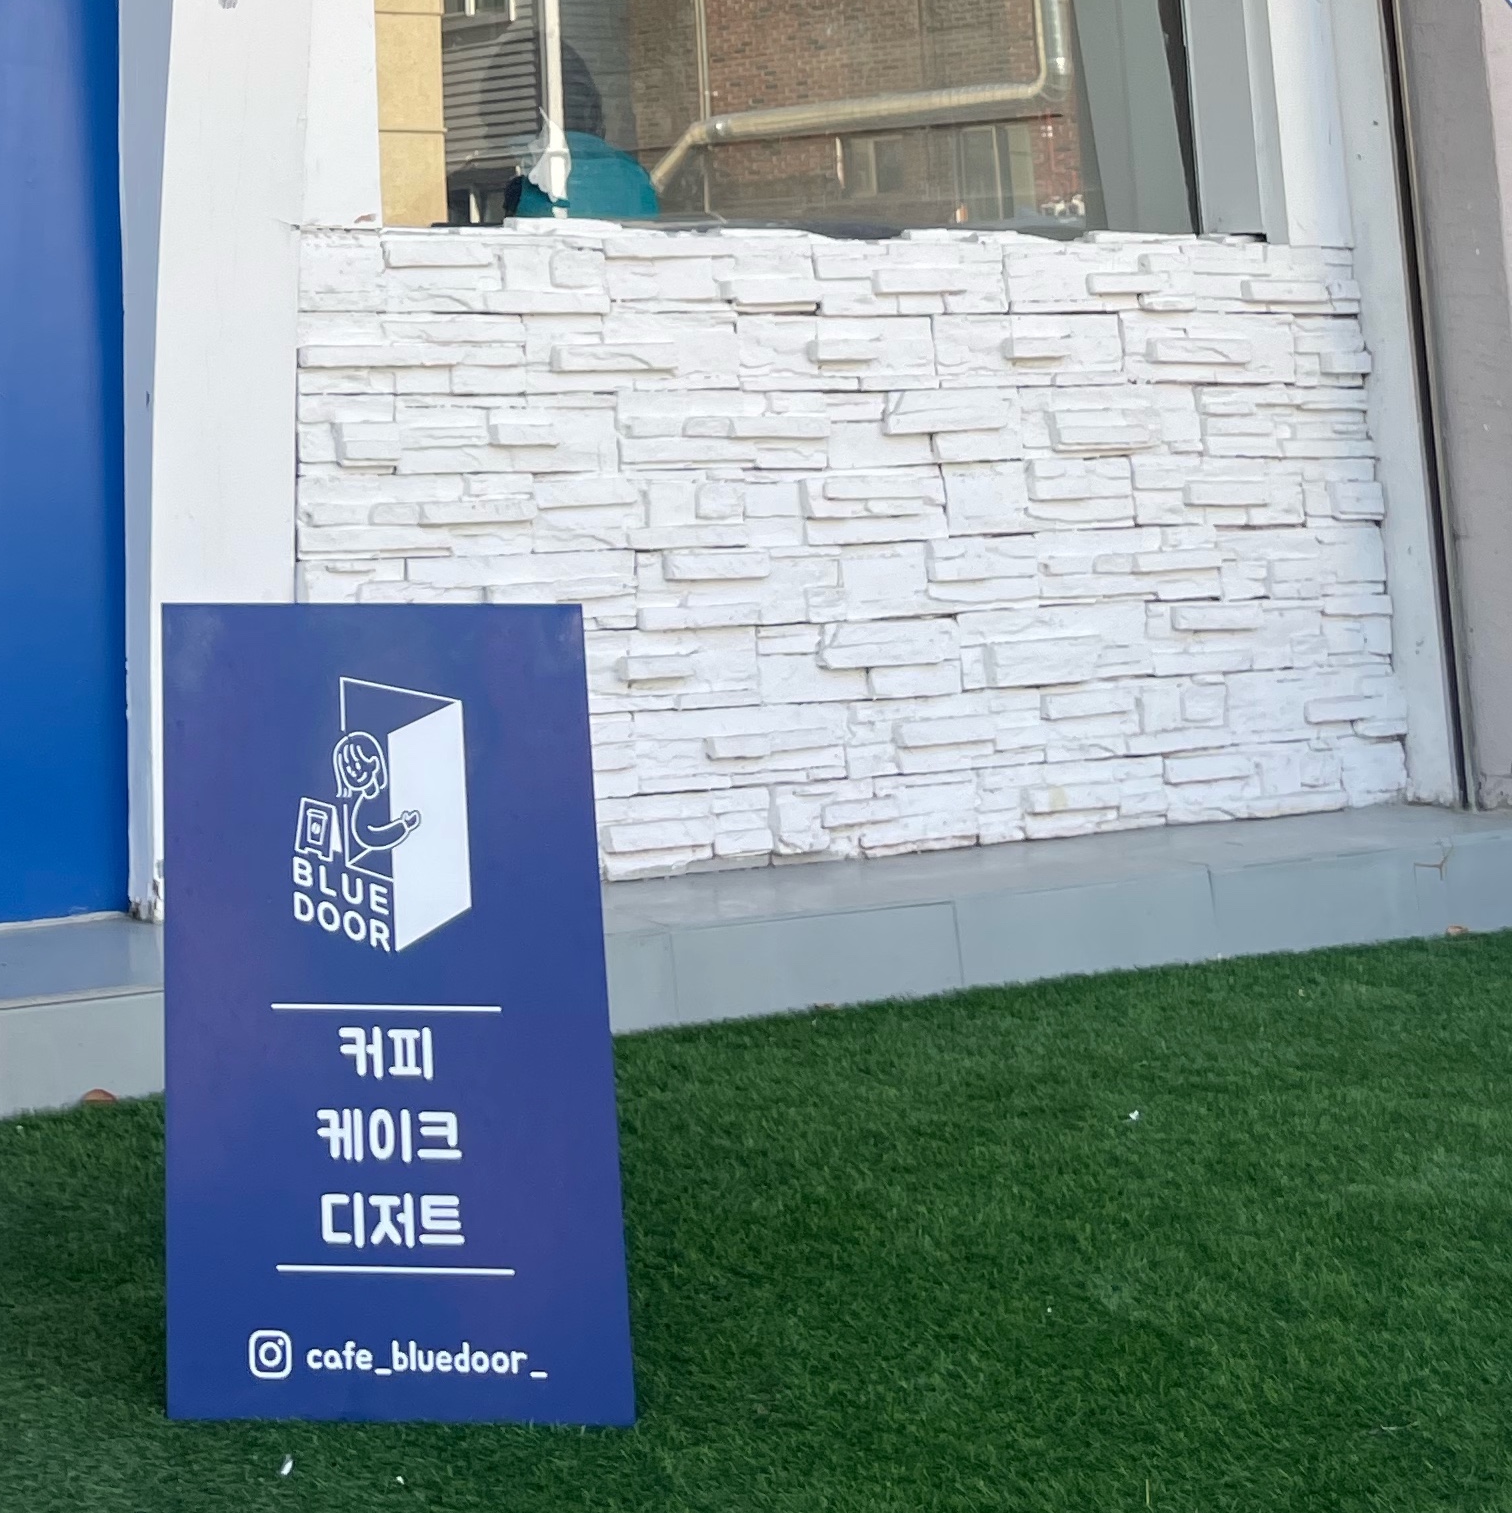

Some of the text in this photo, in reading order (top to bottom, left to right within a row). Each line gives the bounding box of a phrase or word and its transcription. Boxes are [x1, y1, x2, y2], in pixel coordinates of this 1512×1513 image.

[292, 856, 390, 916] BLUE
[293, 891, 391, 953] DOOR
[338, 1026, 435, 1080] 커피
[316, 1108, 463, 1163] 케이크
[321, 1192, 466, 1249] 디저트
[306, 1340, 548, 1378] cafe_bluedoor_
